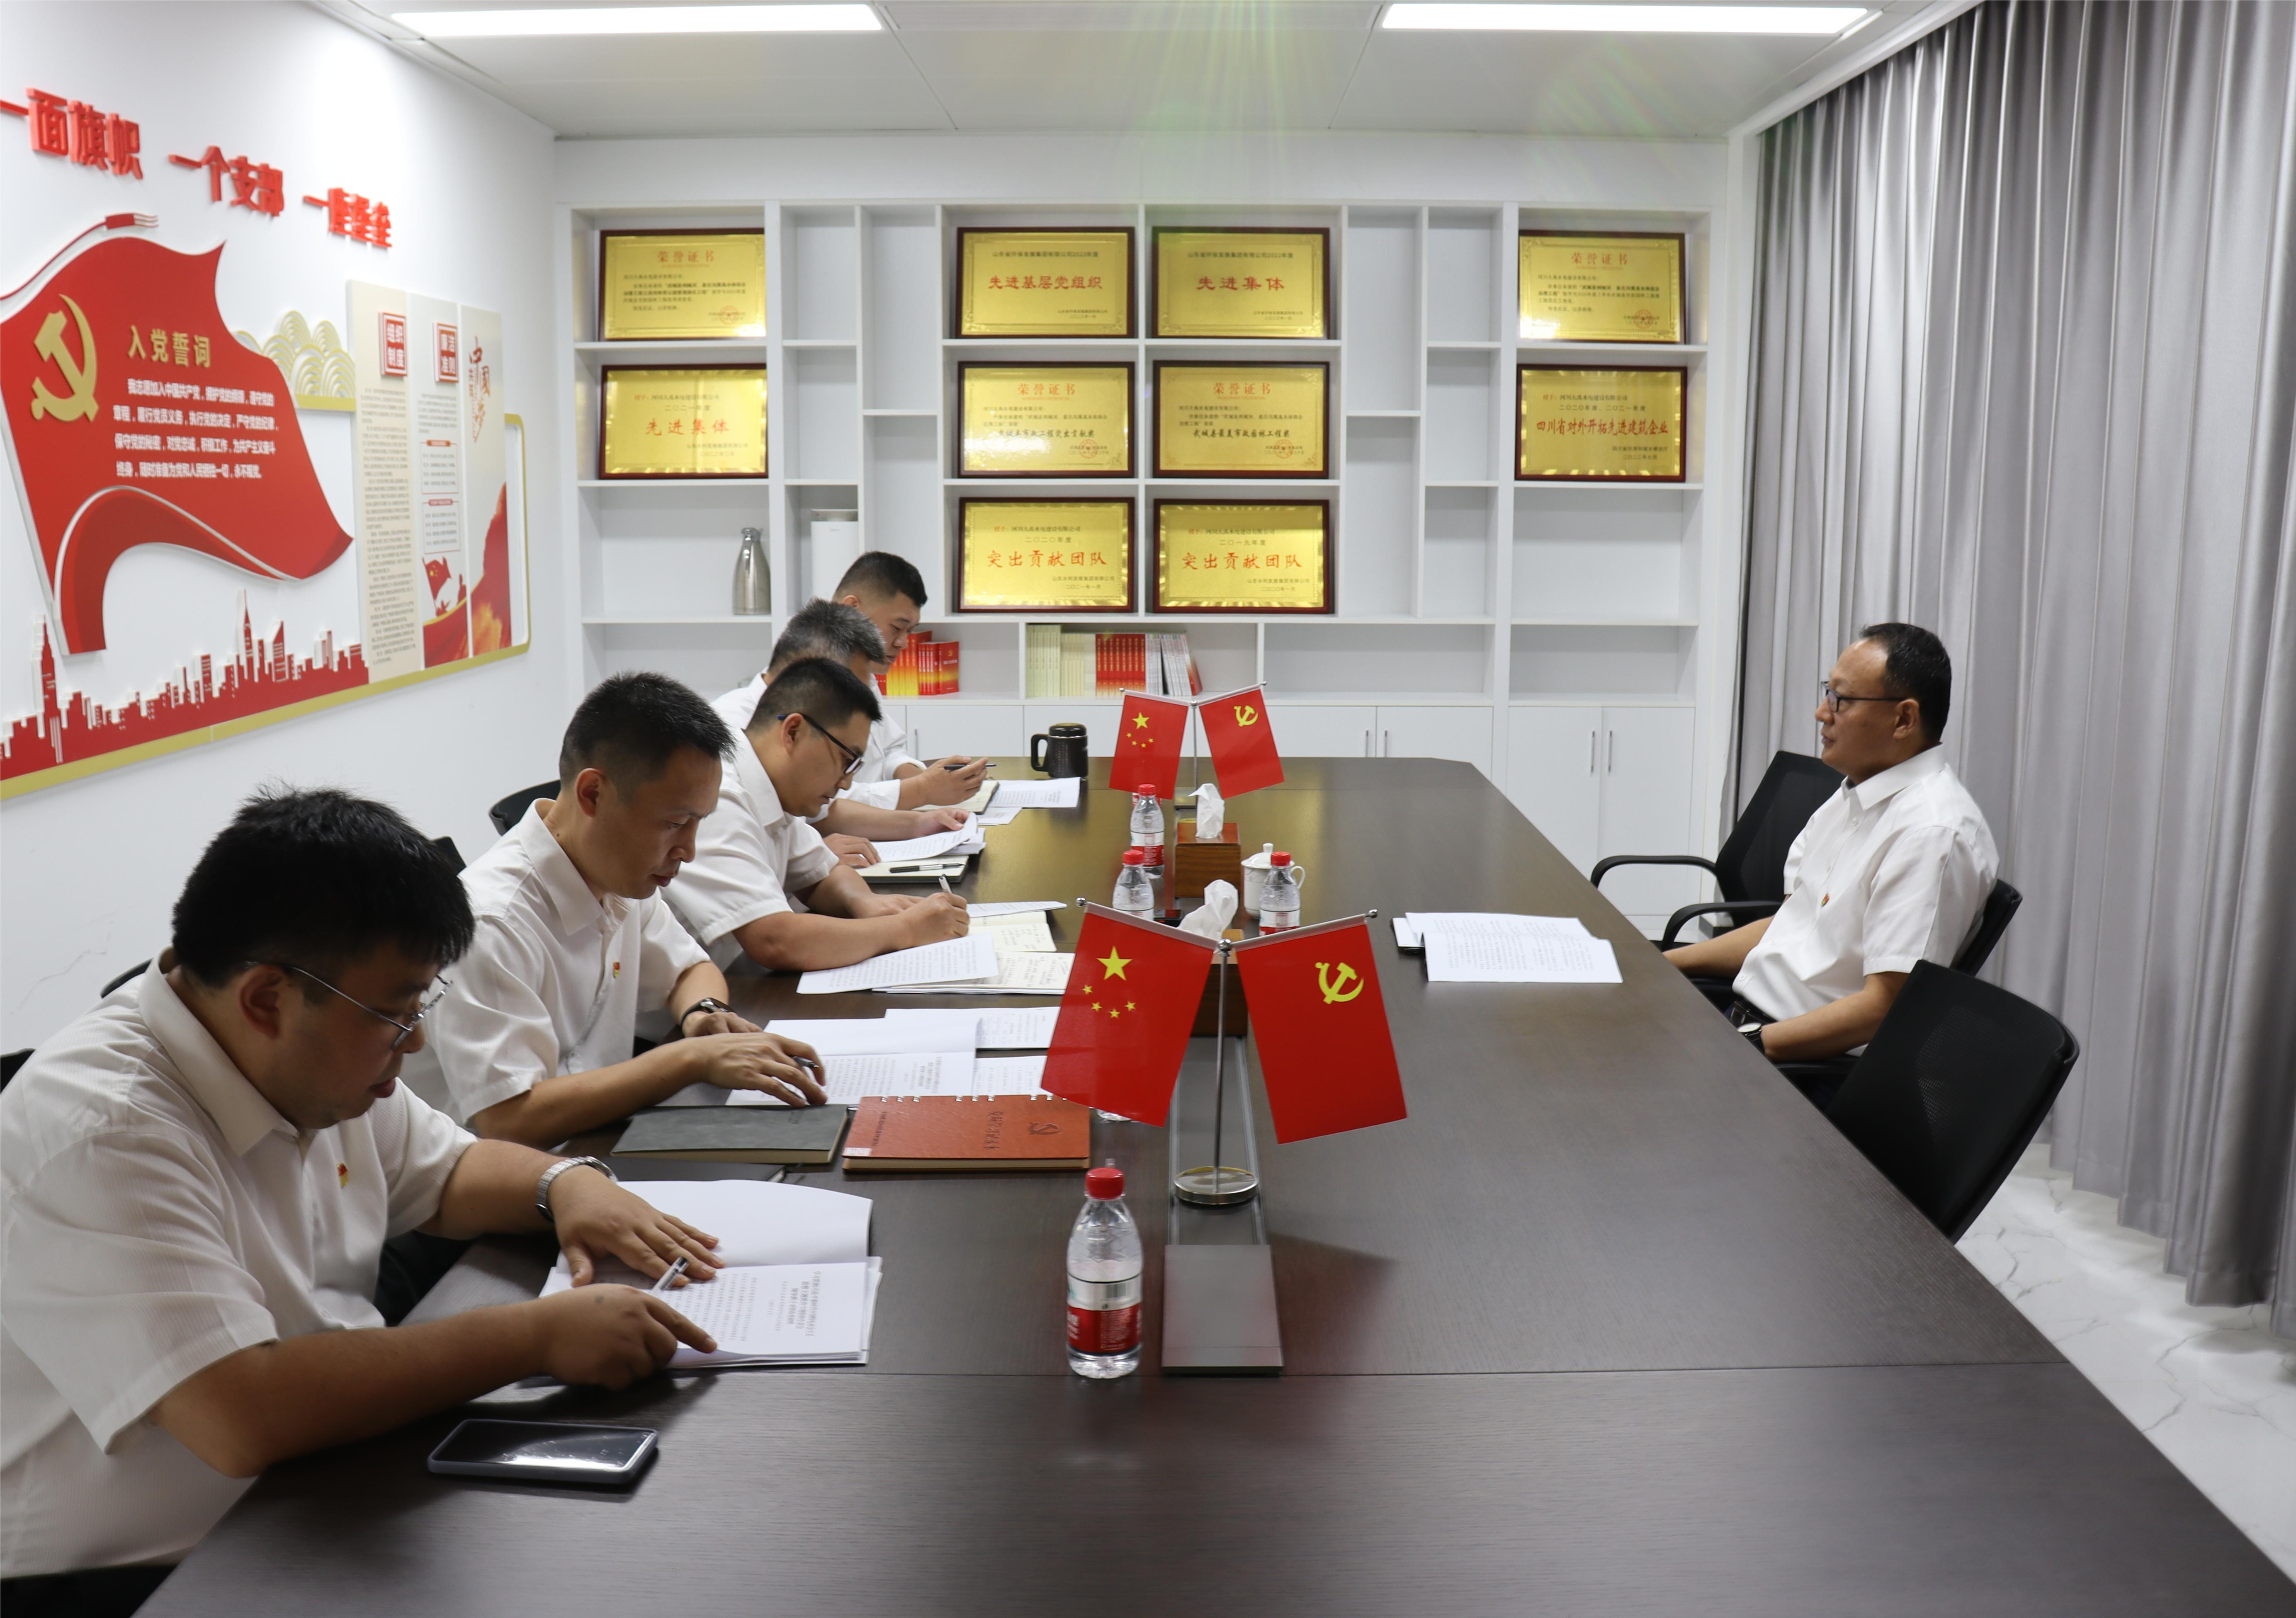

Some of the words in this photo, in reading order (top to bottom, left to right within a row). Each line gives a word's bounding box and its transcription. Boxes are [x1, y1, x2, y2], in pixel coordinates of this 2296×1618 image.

[0, 87, 143, 180] 一面旗帜
[168, 145, 284, 217] 一个支部
[658, 250, 714, 262] 荣誉证书
[1572, 252, 1628, 265] 荣誉证书
[989, 276, 1103, 290] 先进基层党组织
[1196, 276, 1285, 291] 先进集体
[128, 325, 210, 368] 入党誓词
[1018, 383, 1076, 395] 荣誉证书
[1213, 383, 1271, 395] 荣誉证书
[646, 419, 729, 436] 先进集体
[1536, 418, 1669, 436] 四川省对外开拓先进建筑企业
[987, 550, 1108, 568] 突出贡献团队
[1181, 552, 1302, 570] 突出贡献团队
